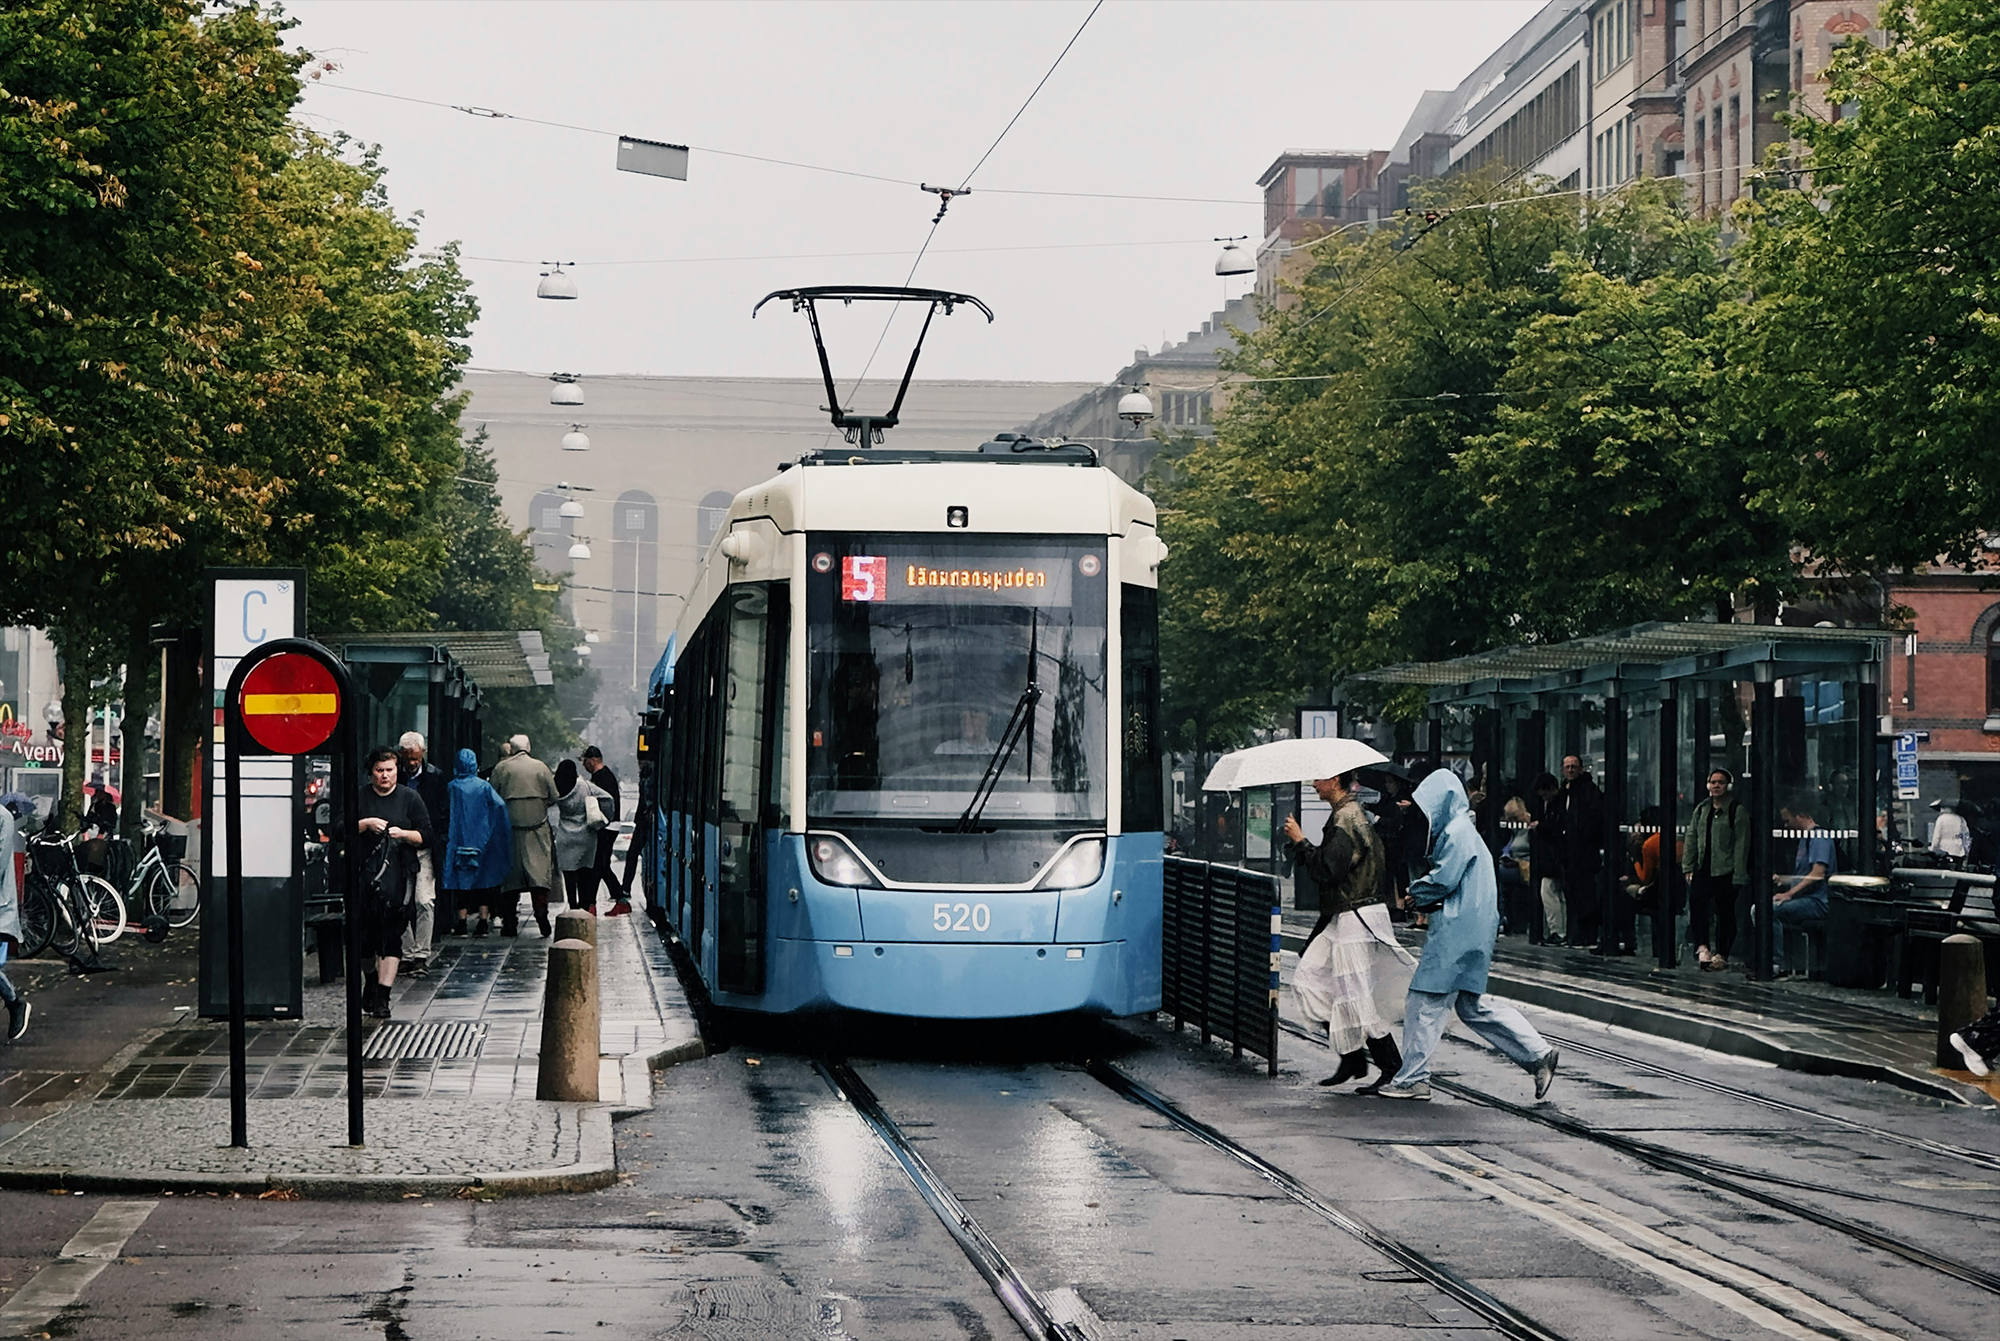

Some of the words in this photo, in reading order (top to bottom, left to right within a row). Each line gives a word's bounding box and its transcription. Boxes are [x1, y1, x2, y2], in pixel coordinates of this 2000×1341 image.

[853, 556, 875, 601] 5
[243, 590, 267, 643] C
[1901, 734, 1913, 751] P
[933, 903, 991, 932] 520
